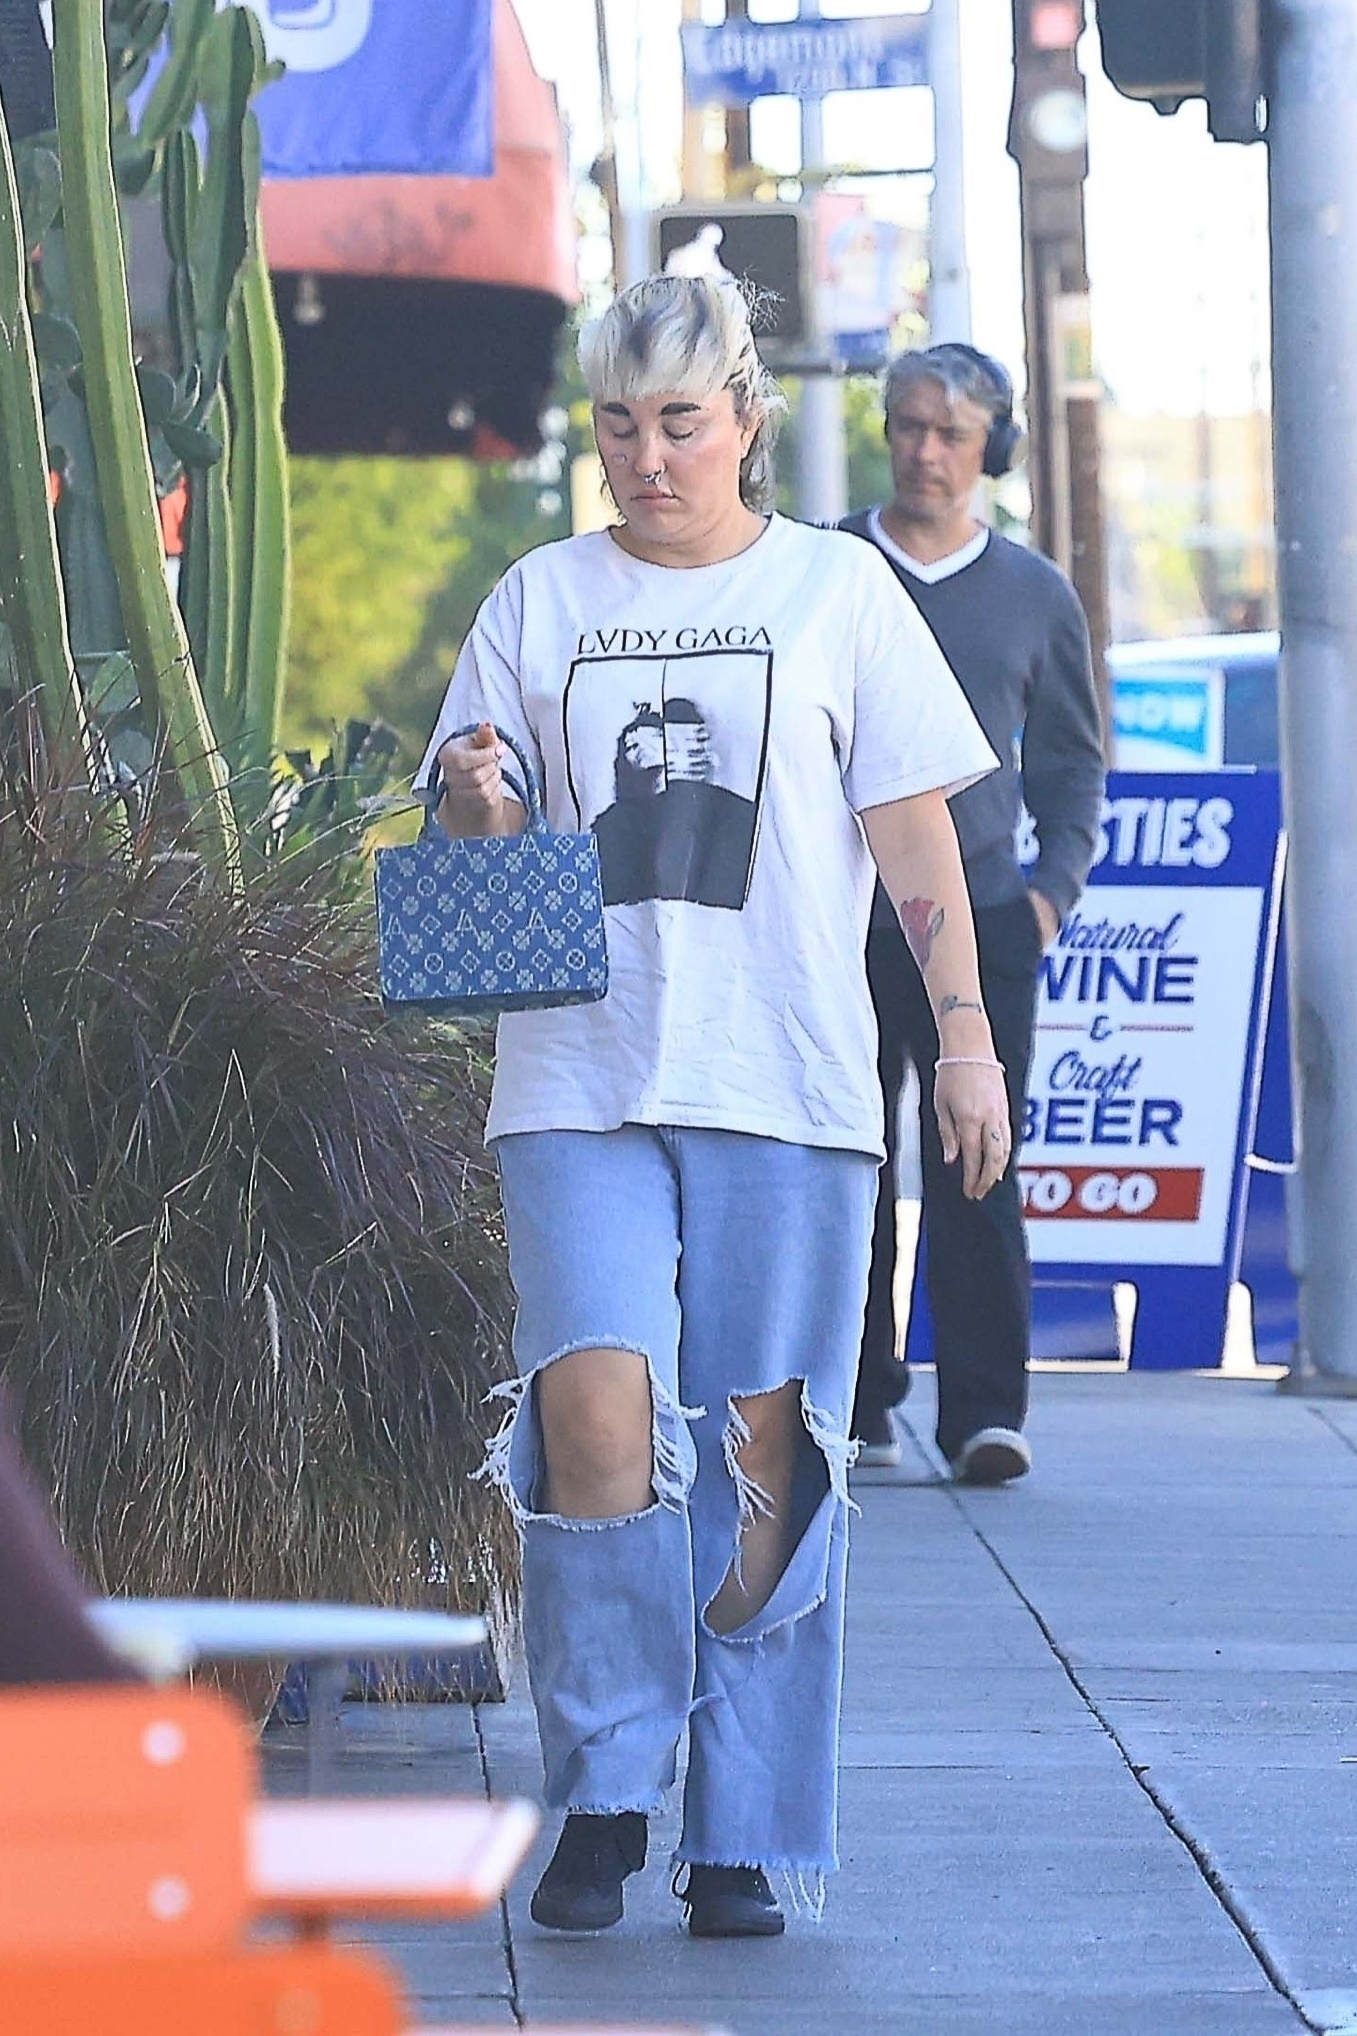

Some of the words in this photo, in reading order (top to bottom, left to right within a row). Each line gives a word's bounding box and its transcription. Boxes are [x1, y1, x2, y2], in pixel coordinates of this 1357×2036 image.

[675, 625, 771, 650] GAGA
[1058, 912, 1185, 951] Natural
[1049, 1050, 1143, 1100] Craft
[1079, 1171, 1159, 1215] GO
